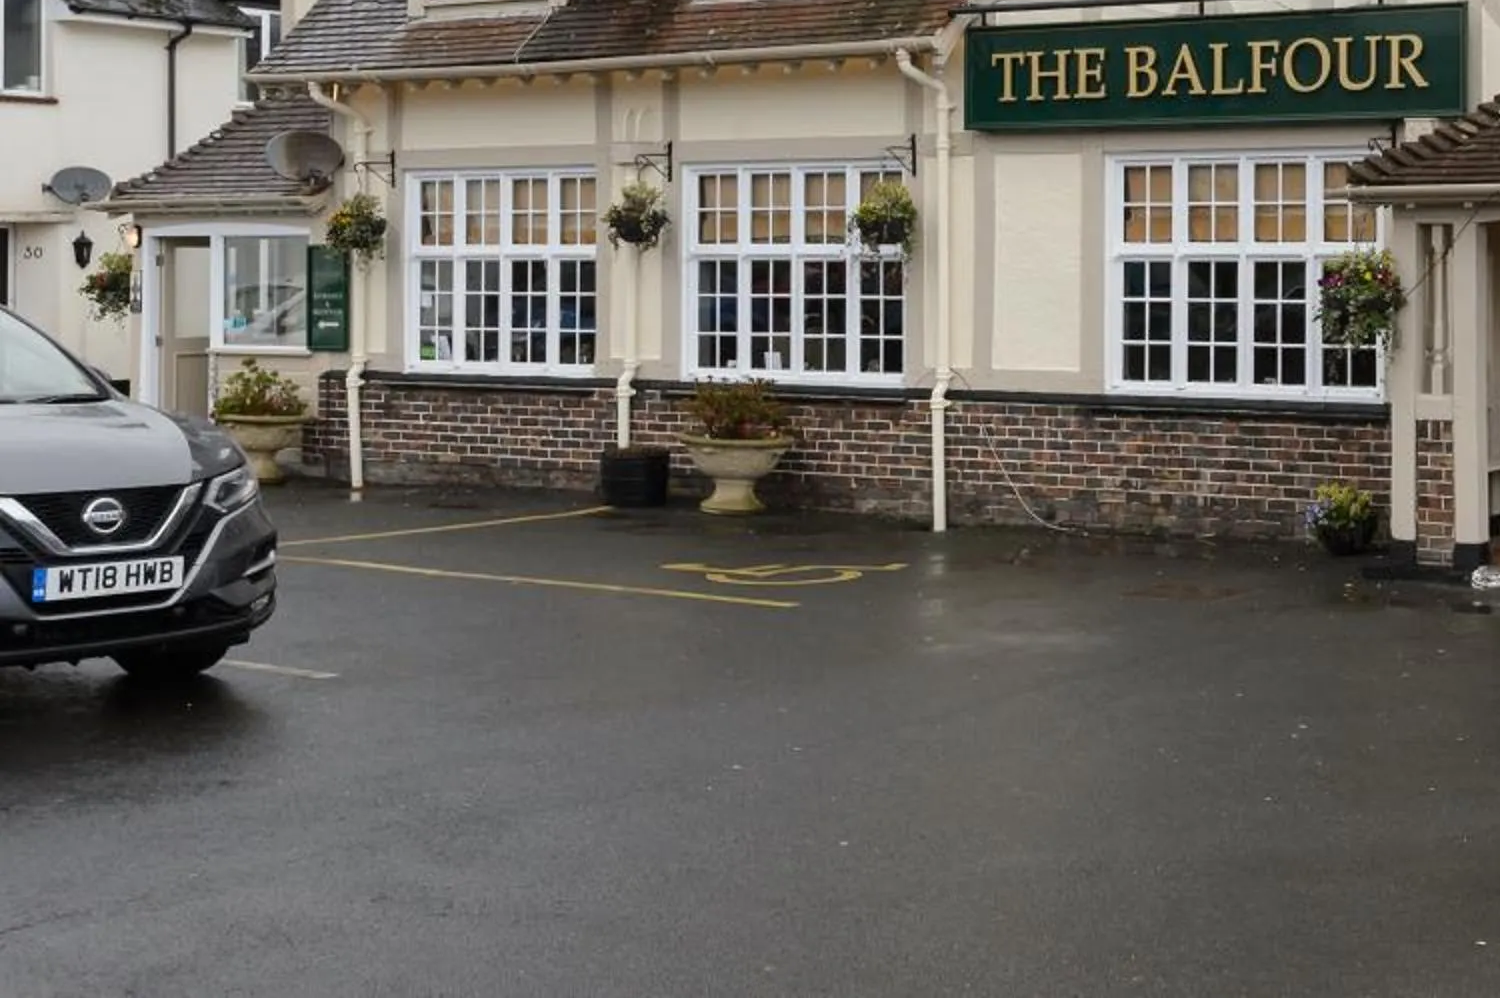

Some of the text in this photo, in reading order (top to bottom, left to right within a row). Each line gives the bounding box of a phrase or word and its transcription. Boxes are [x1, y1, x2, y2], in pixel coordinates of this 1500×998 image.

[991, 33, 1430, 102] THE BALFOUR
[58, 560, 174, 594] WT18 HWB
